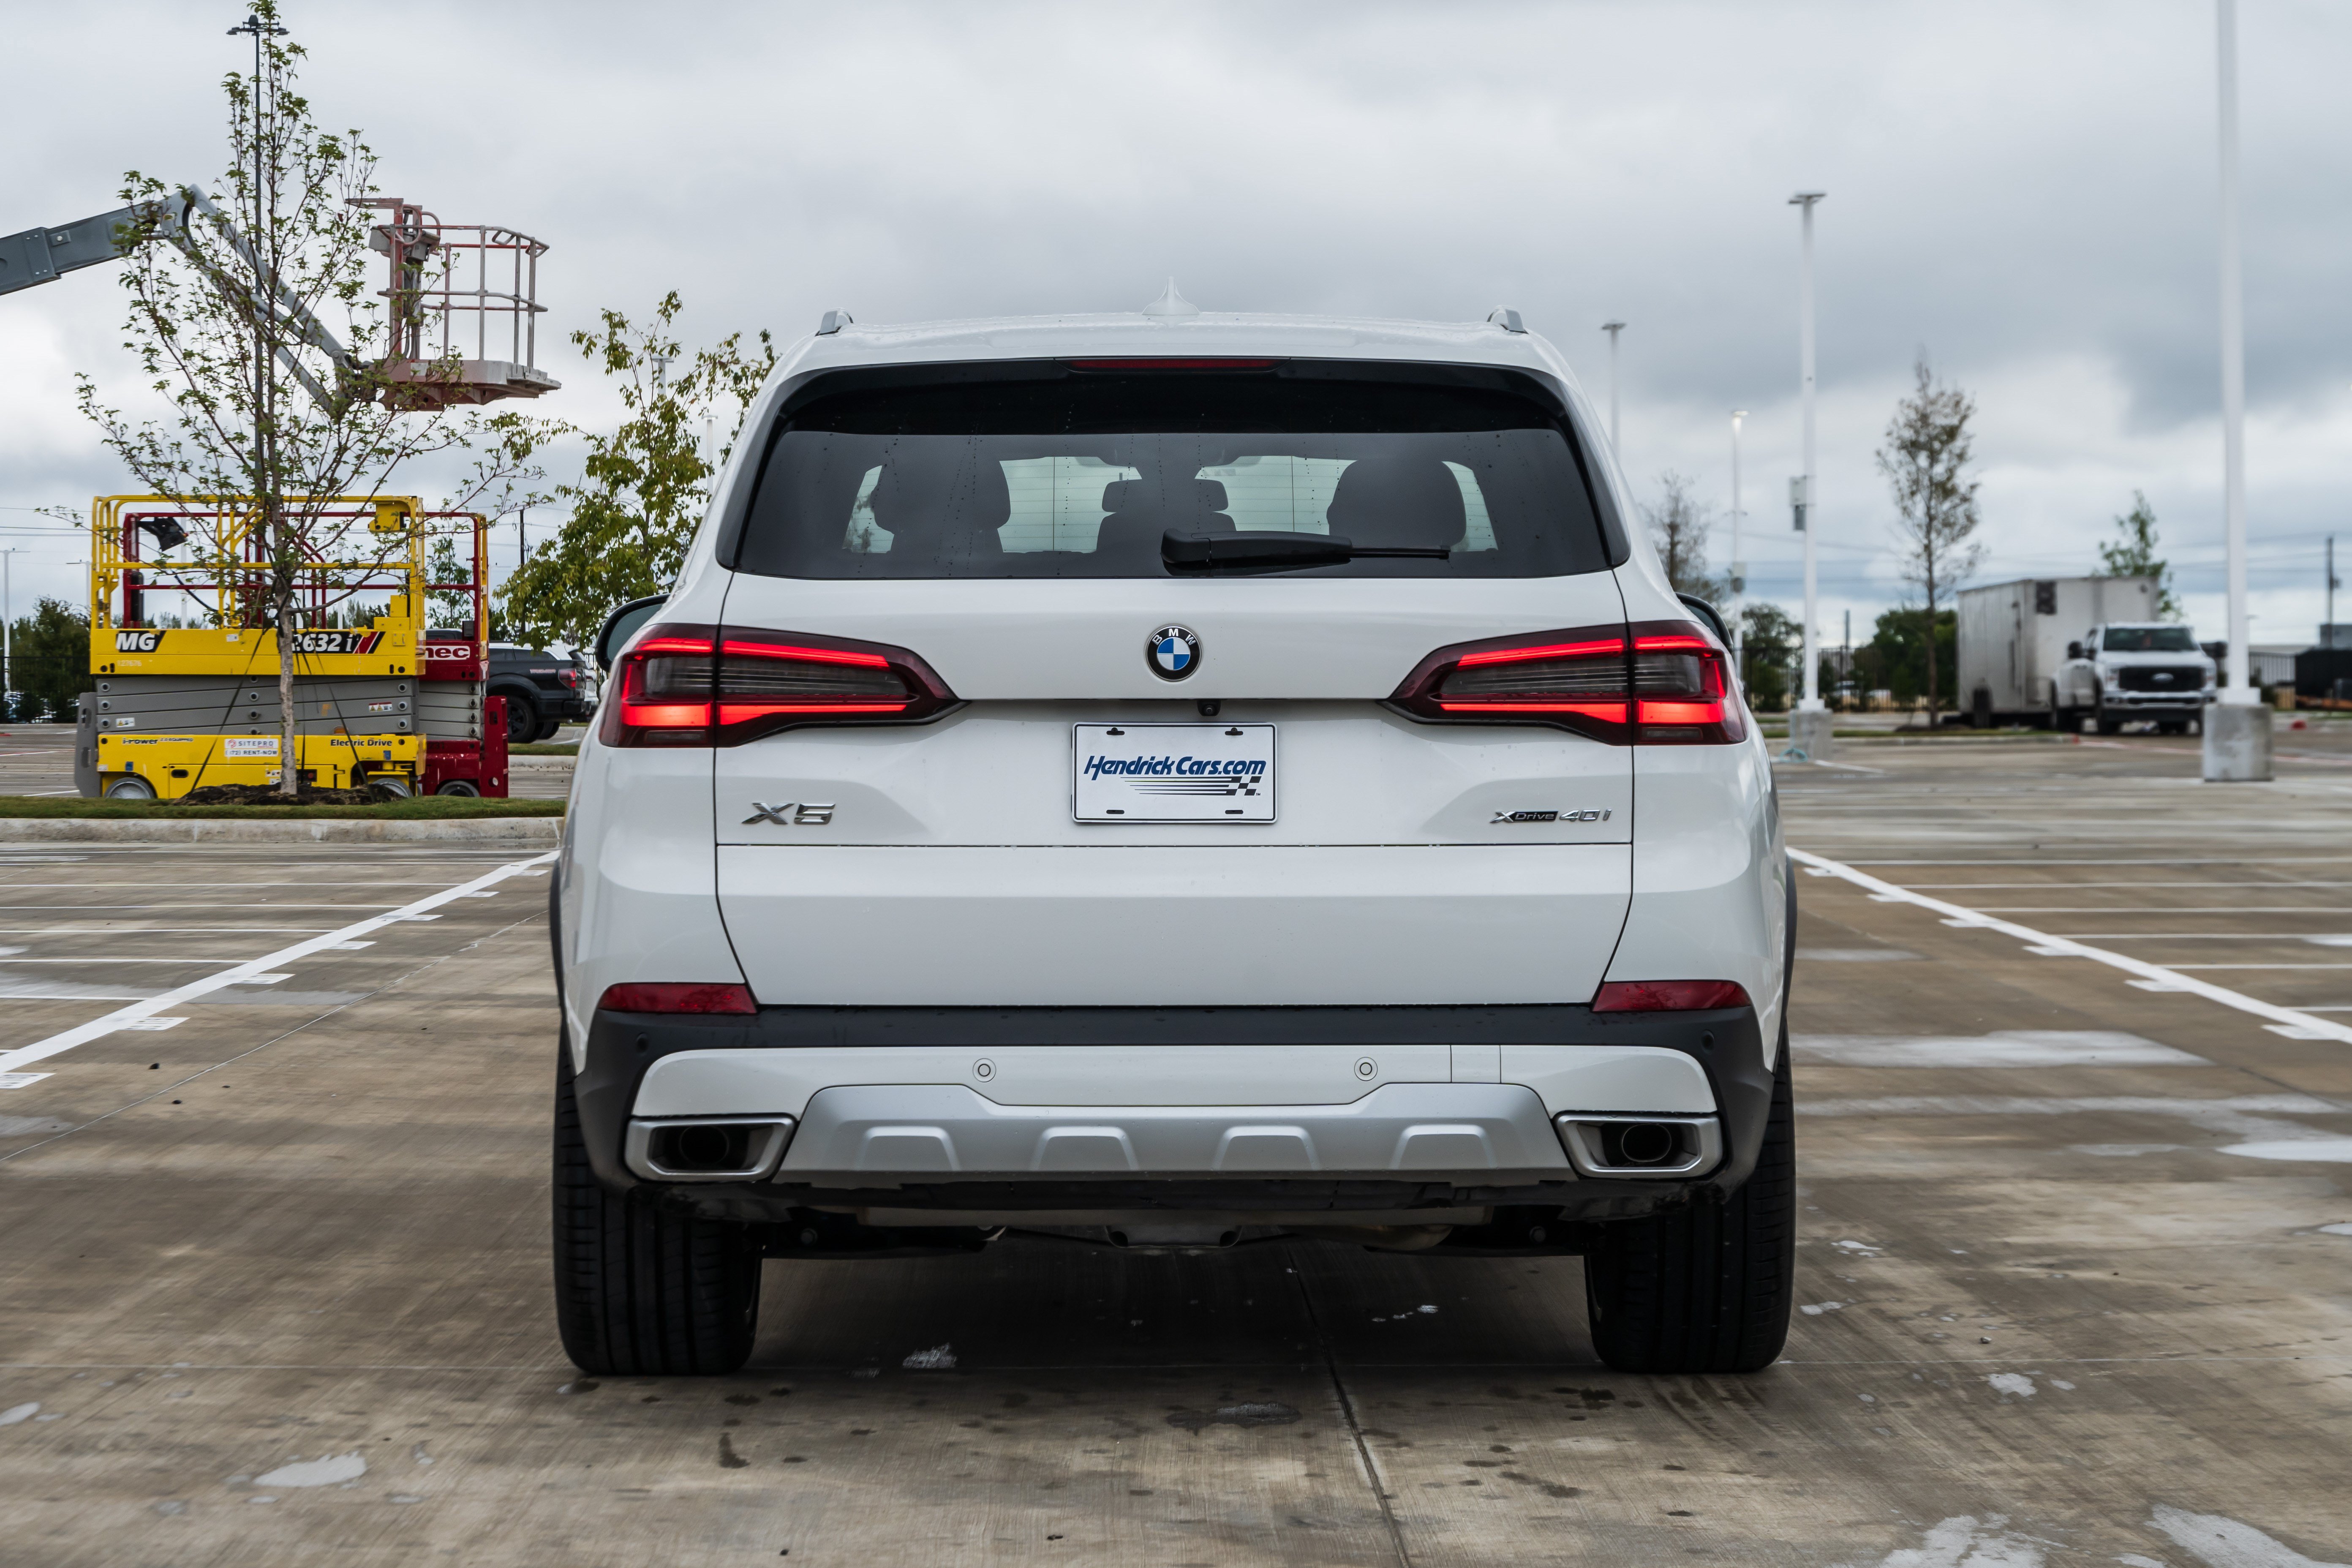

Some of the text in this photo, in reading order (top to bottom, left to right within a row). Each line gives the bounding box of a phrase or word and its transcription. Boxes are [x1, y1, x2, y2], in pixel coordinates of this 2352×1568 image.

[116, 633, 155, 650] MG
[1152, 628, 1197, 645] BMW
[741, 802, 836, 825] X5
